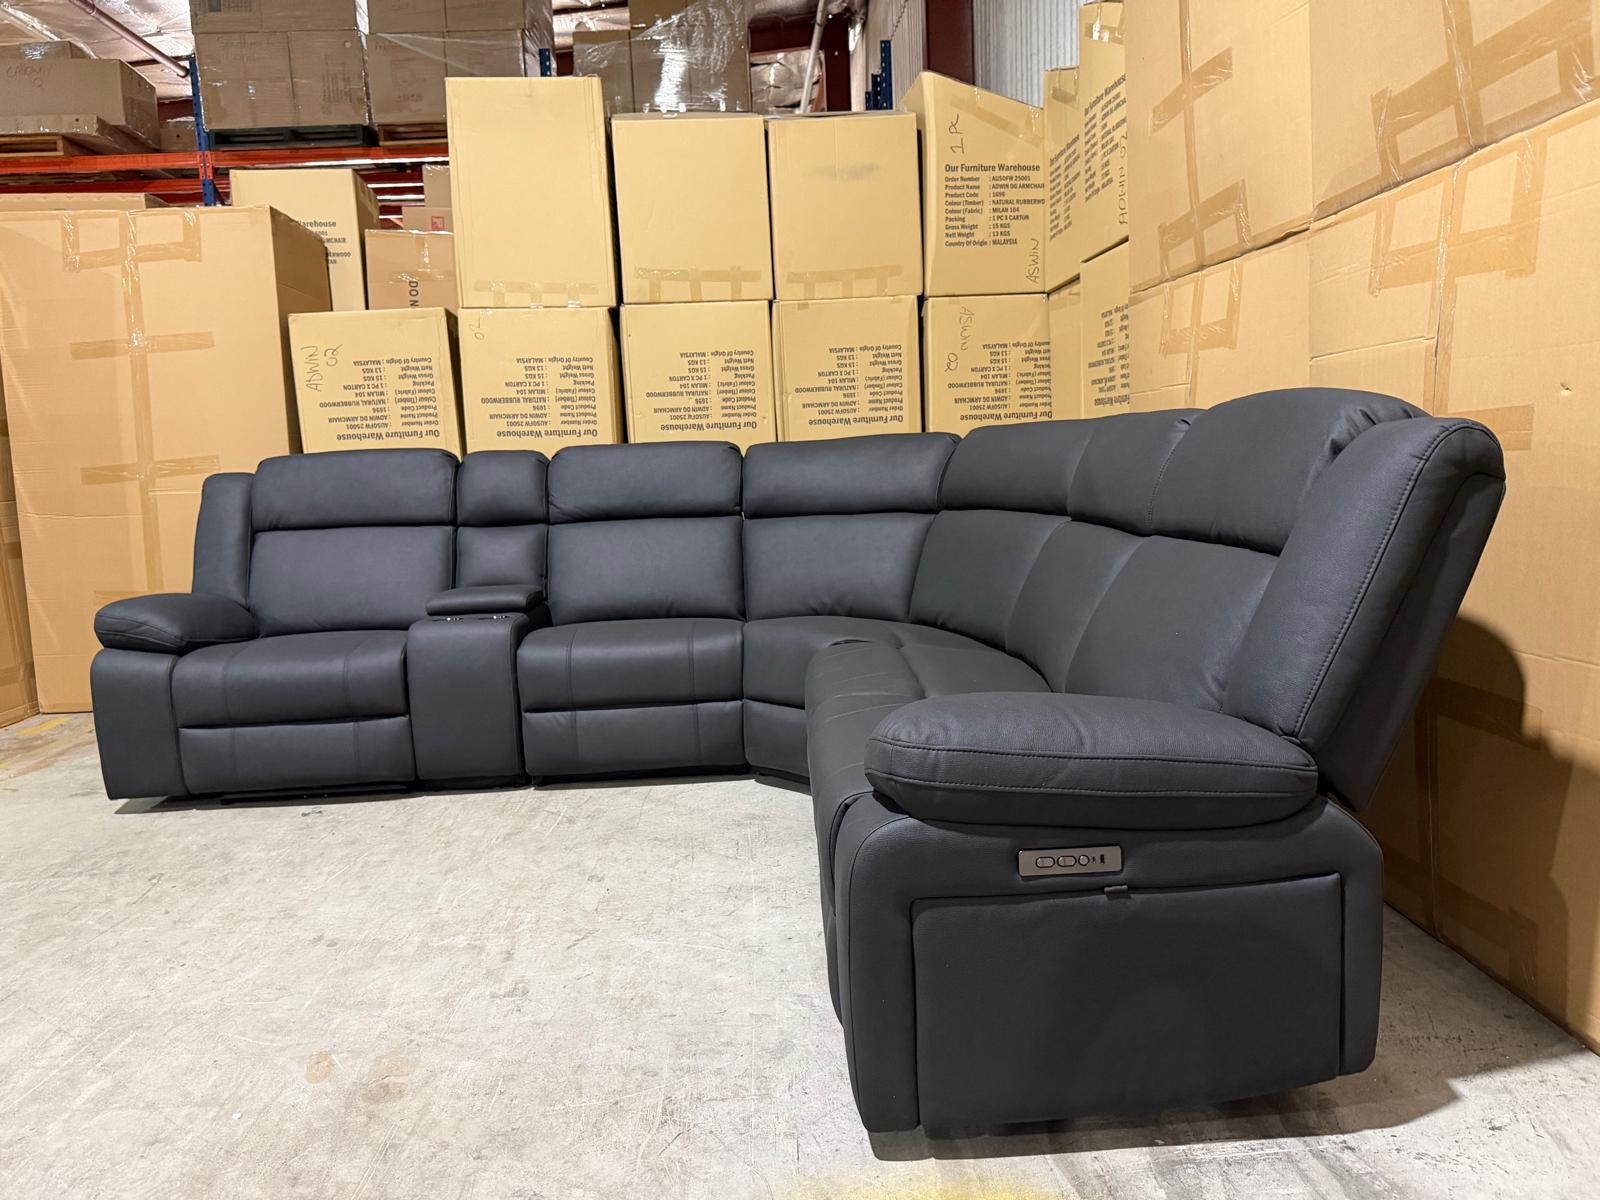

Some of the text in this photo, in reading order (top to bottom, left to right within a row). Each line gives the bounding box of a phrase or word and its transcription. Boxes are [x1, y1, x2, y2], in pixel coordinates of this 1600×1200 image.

[945, 163, 1040, 172] Our Furniture Warehouse
[300, 220, 337, 228] arehouse
[1025, 238, 1040, 284] ASWIN
[408, 281, 419, 296] DO
[300, 345, 323, 392] ADWIN
[808, 415, 903, 427] Our Furniture Warehouse
[959, 410, 1053, 422] Our Furniture Warehouse
[660, 421, 757, 432] Our Furniture Warehouse
[336, 429, 440, 442] Our Furniture Warehouse
[496, 429, 598, 438] Our Furniture Warehouse
